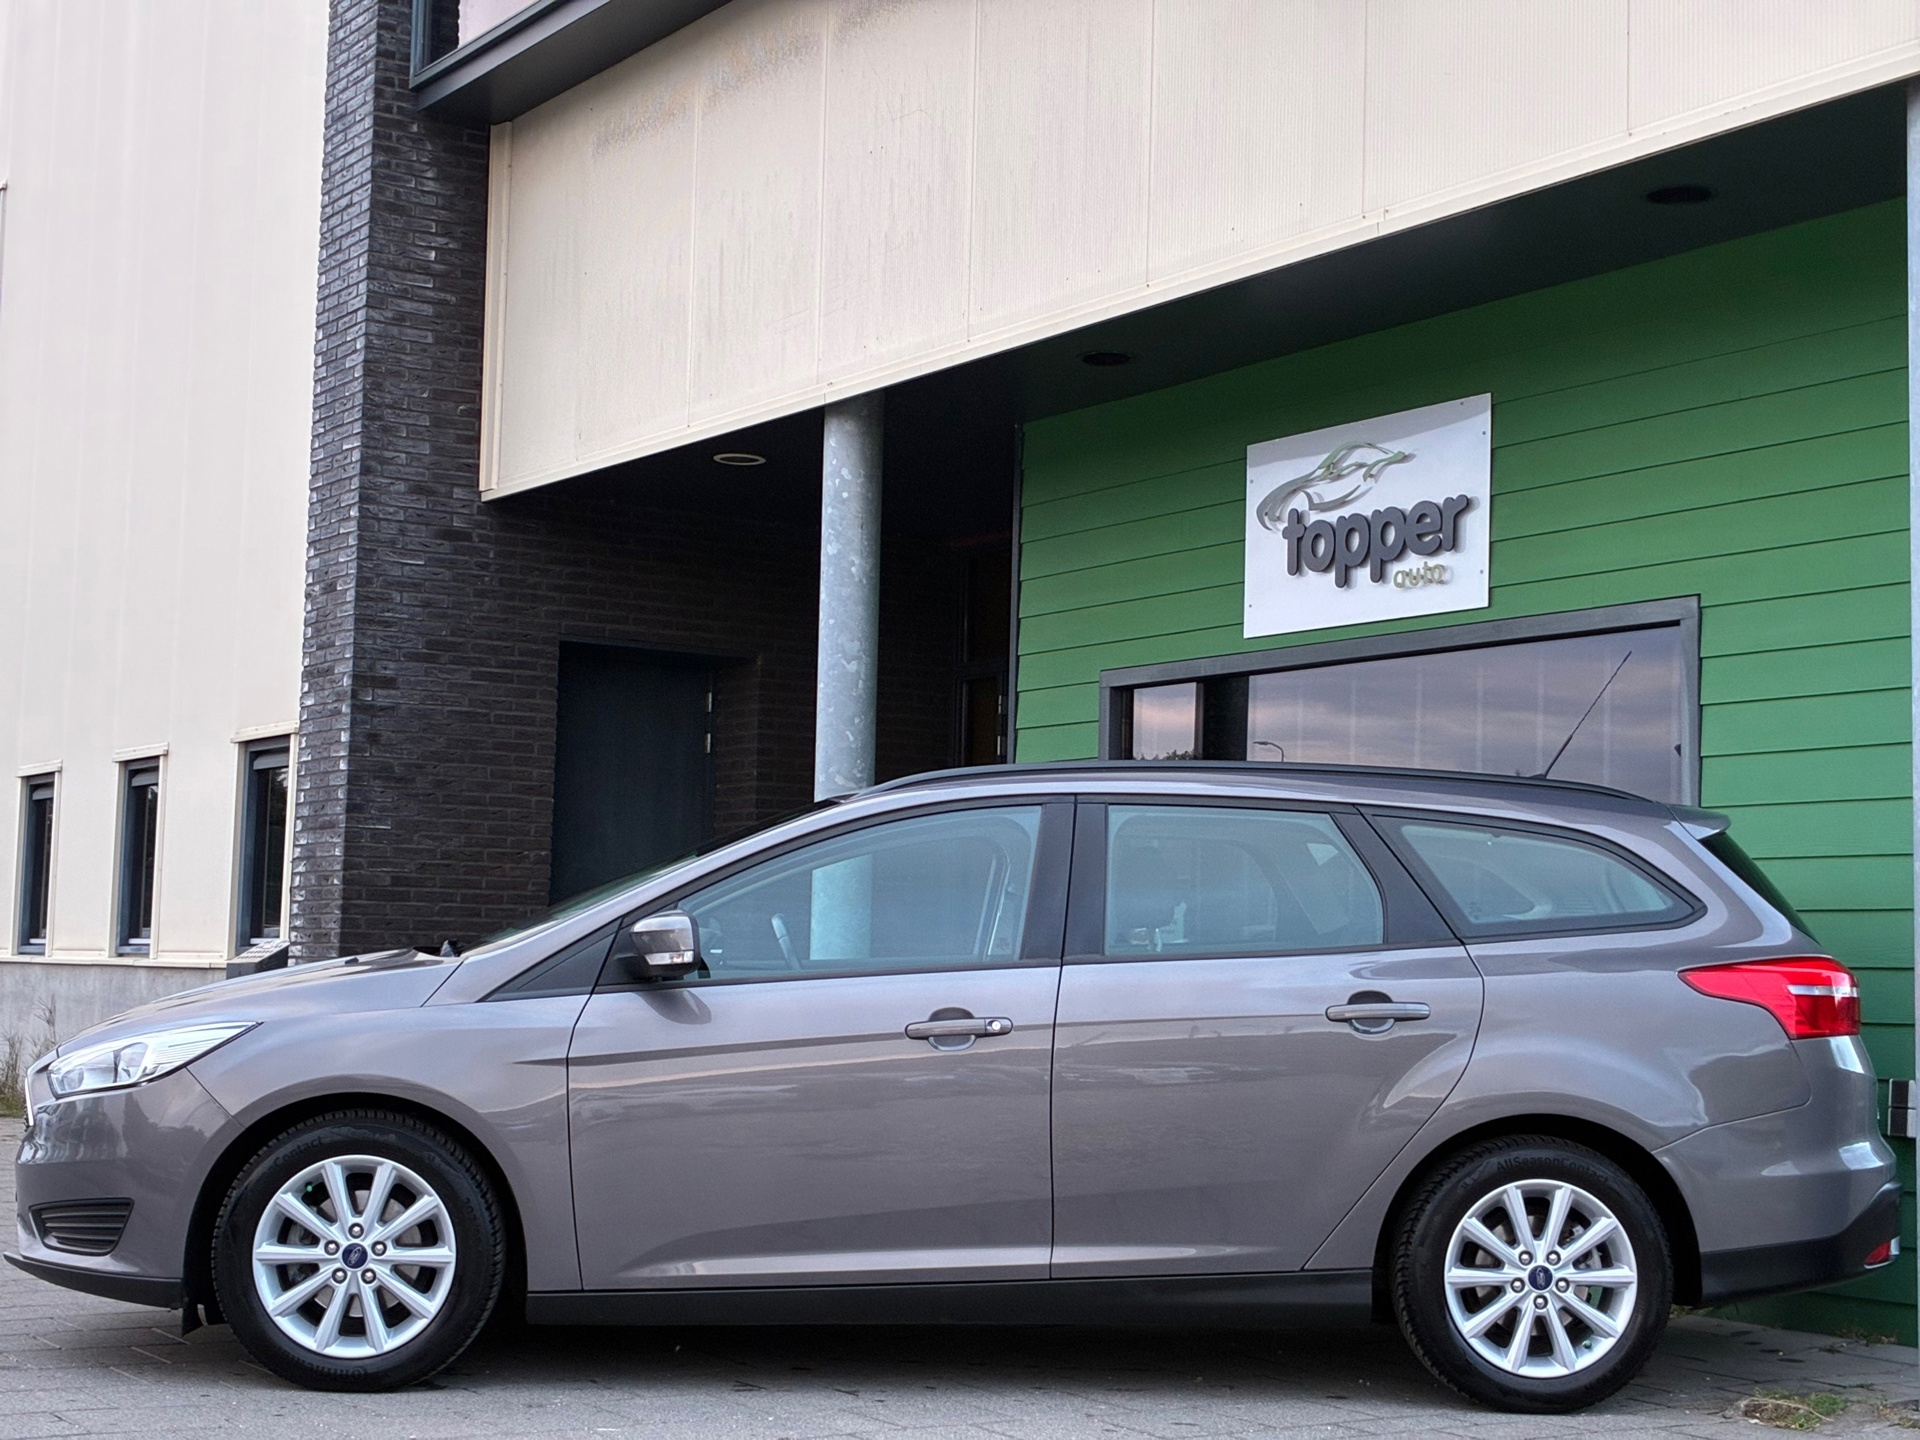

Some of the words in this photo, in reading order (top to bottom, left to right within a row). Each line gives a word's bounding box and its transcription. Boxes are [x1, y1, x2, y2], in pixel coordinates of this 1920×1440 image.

[1282, 494, 1469, 588] topper
[1393, 561, 1446, 589] auto
[1496, 1155, 1610, 1183] AllSeasonContact
